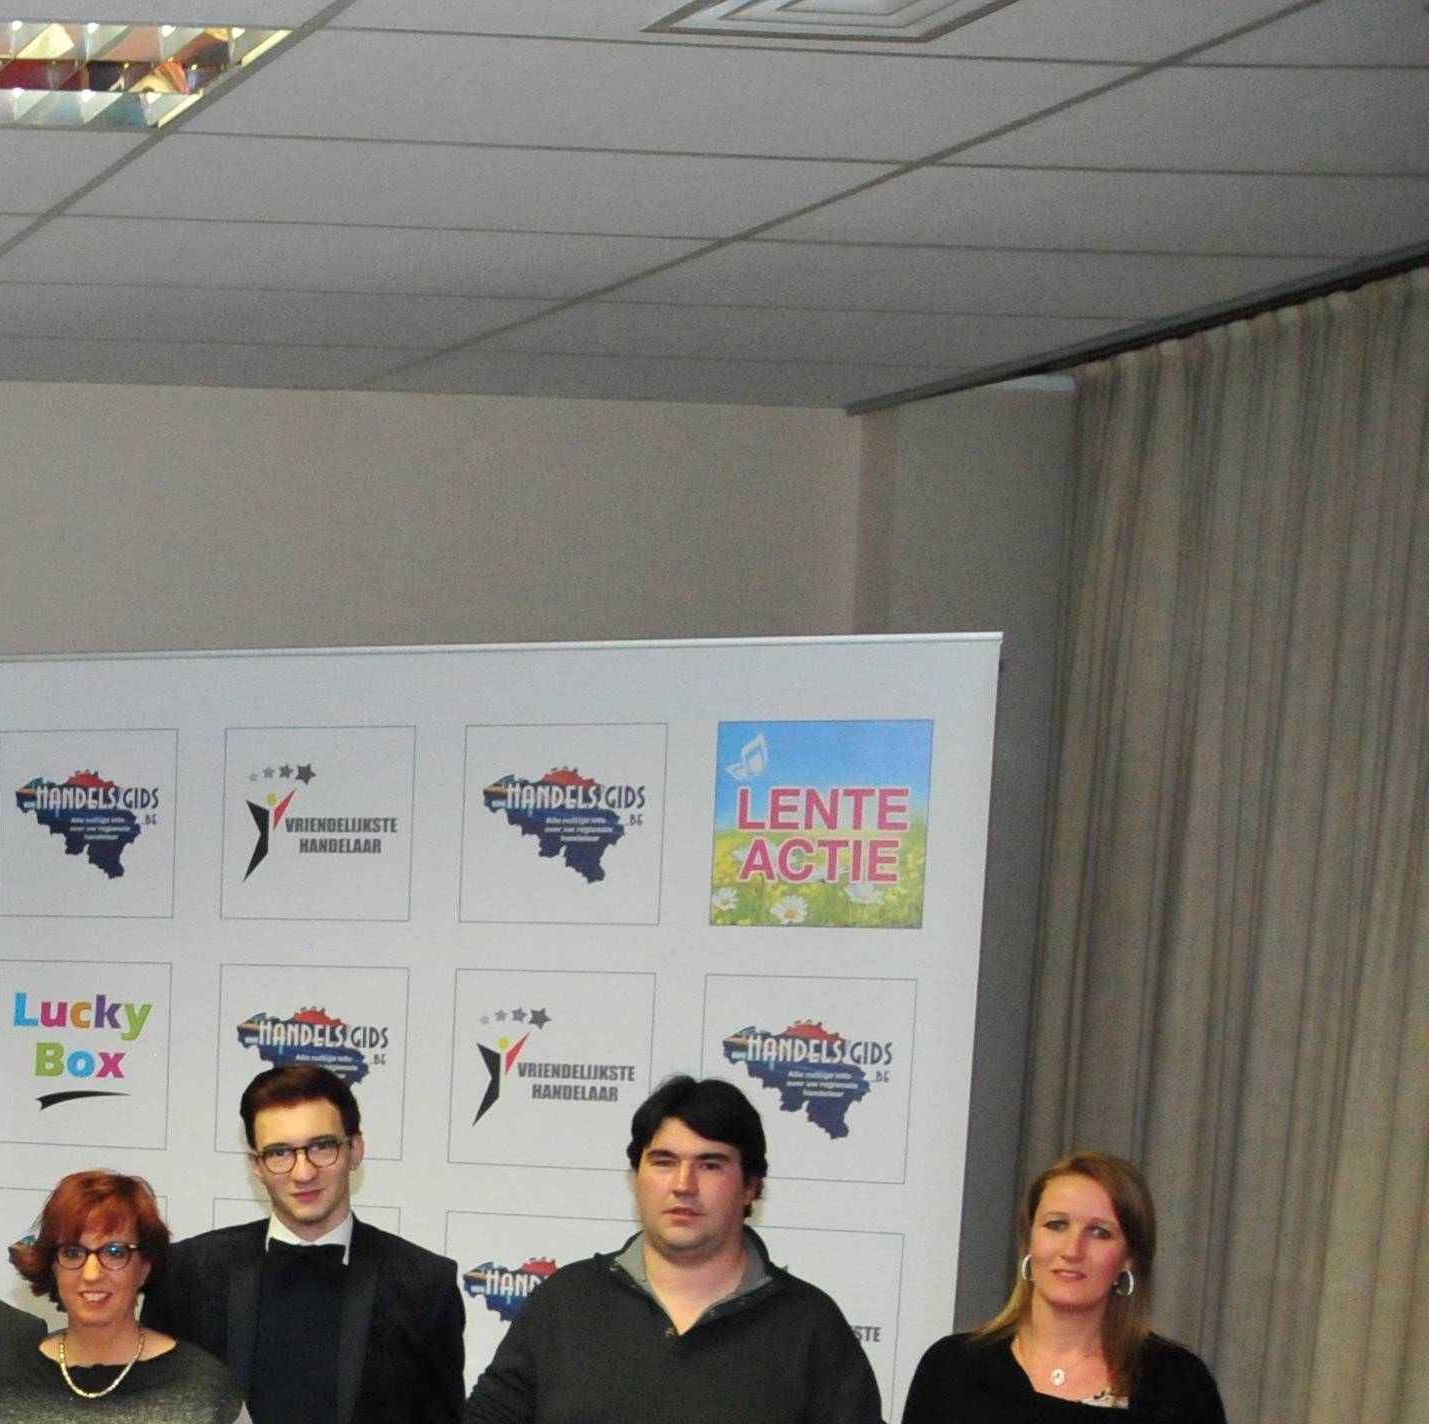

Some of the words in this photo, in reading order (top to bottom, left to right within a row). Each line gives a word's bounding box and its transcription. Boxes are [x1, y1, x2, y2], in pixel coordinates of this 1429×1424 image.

[737, 787, 910, 831] LENTE
[285, 817, 398, 833] VRIENDELIJKSTE
[299, 838, 382, 854] HANDELAAR
[739, 838, 900, 882] ACTIE
[13, 992, 153, 1041] Lucky
[35, 1042, 126, 1078] Box
[517, 1062, 635, 1081] VRIENDELIJKSTE
[532, 1084, 618, 1102] HANDELAAR
